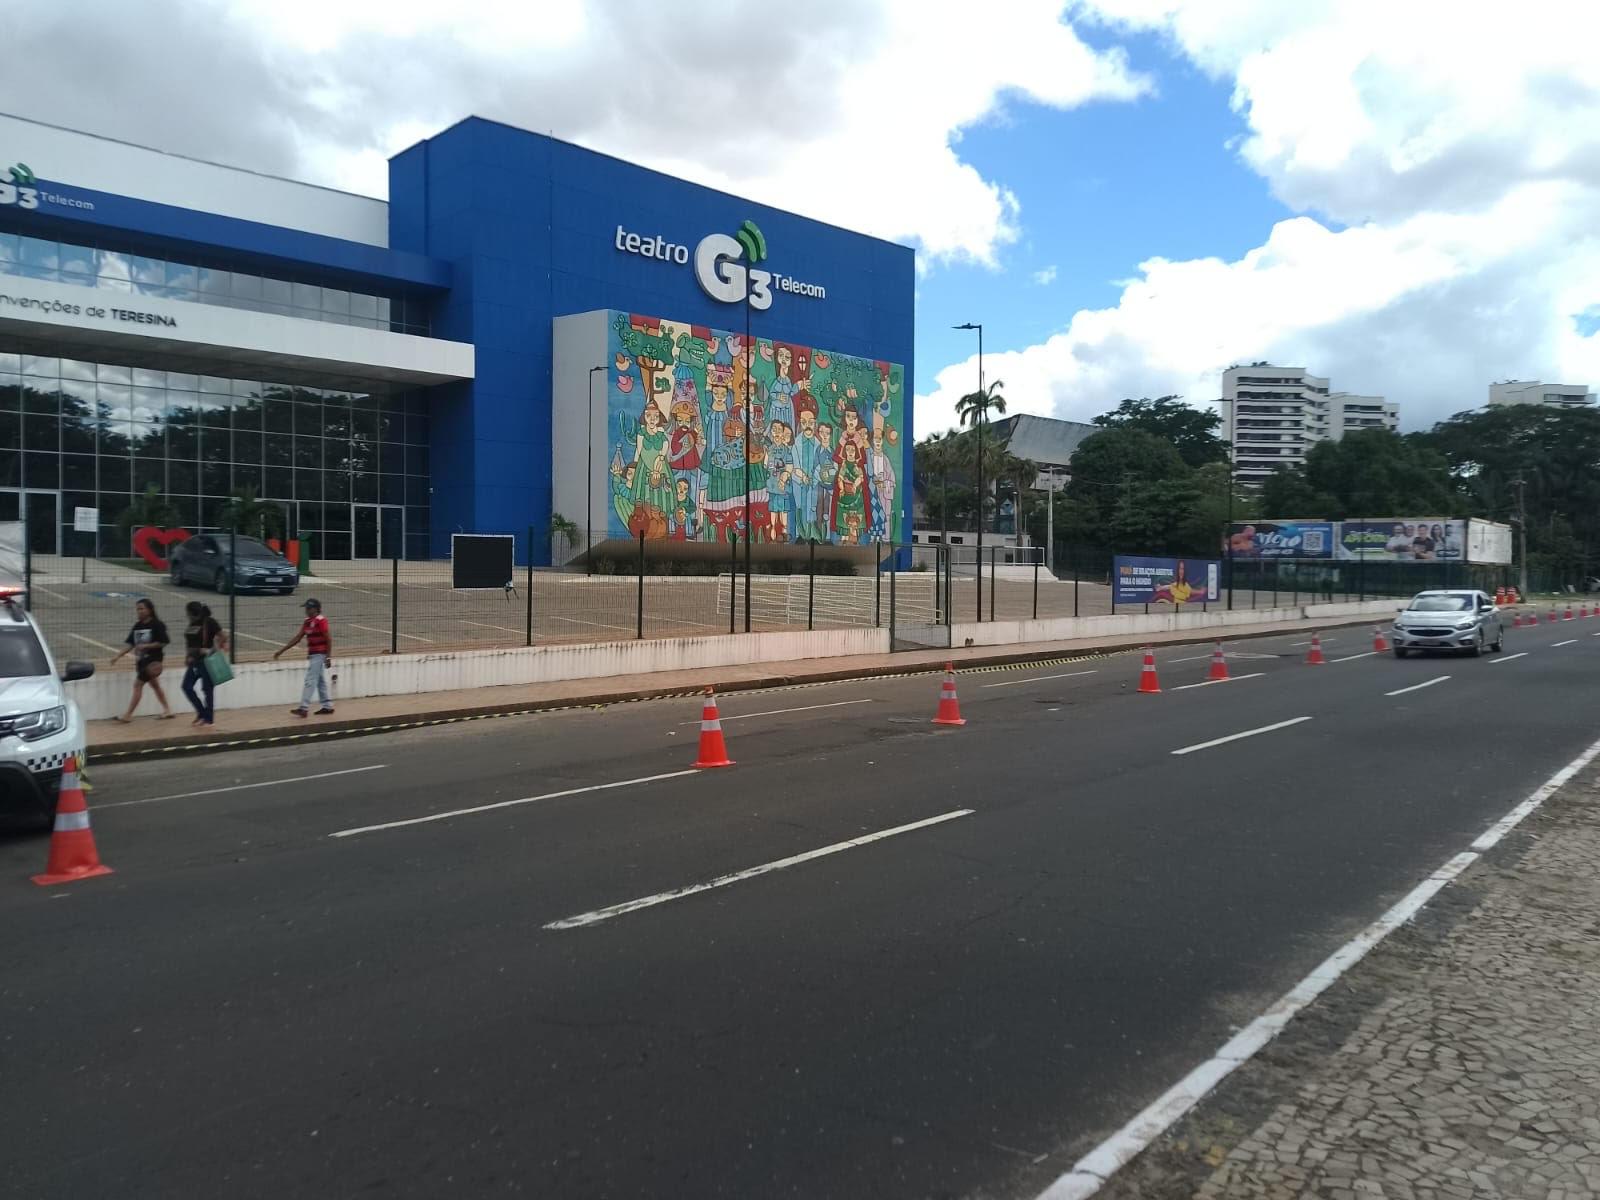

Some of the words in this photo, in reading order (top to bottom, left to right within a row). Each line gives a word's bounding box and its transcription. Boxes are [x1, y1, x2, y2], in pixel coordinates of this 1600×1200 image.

[40, 191, 95, 210] Telecom
[615, 224, 689, 265] teatro
[694, 233, 772, 310] G3
[772, 273, 826, 299] Telecom
[86, 305, 106, 319] de
[111, 308, 177, 328] TERESINA
